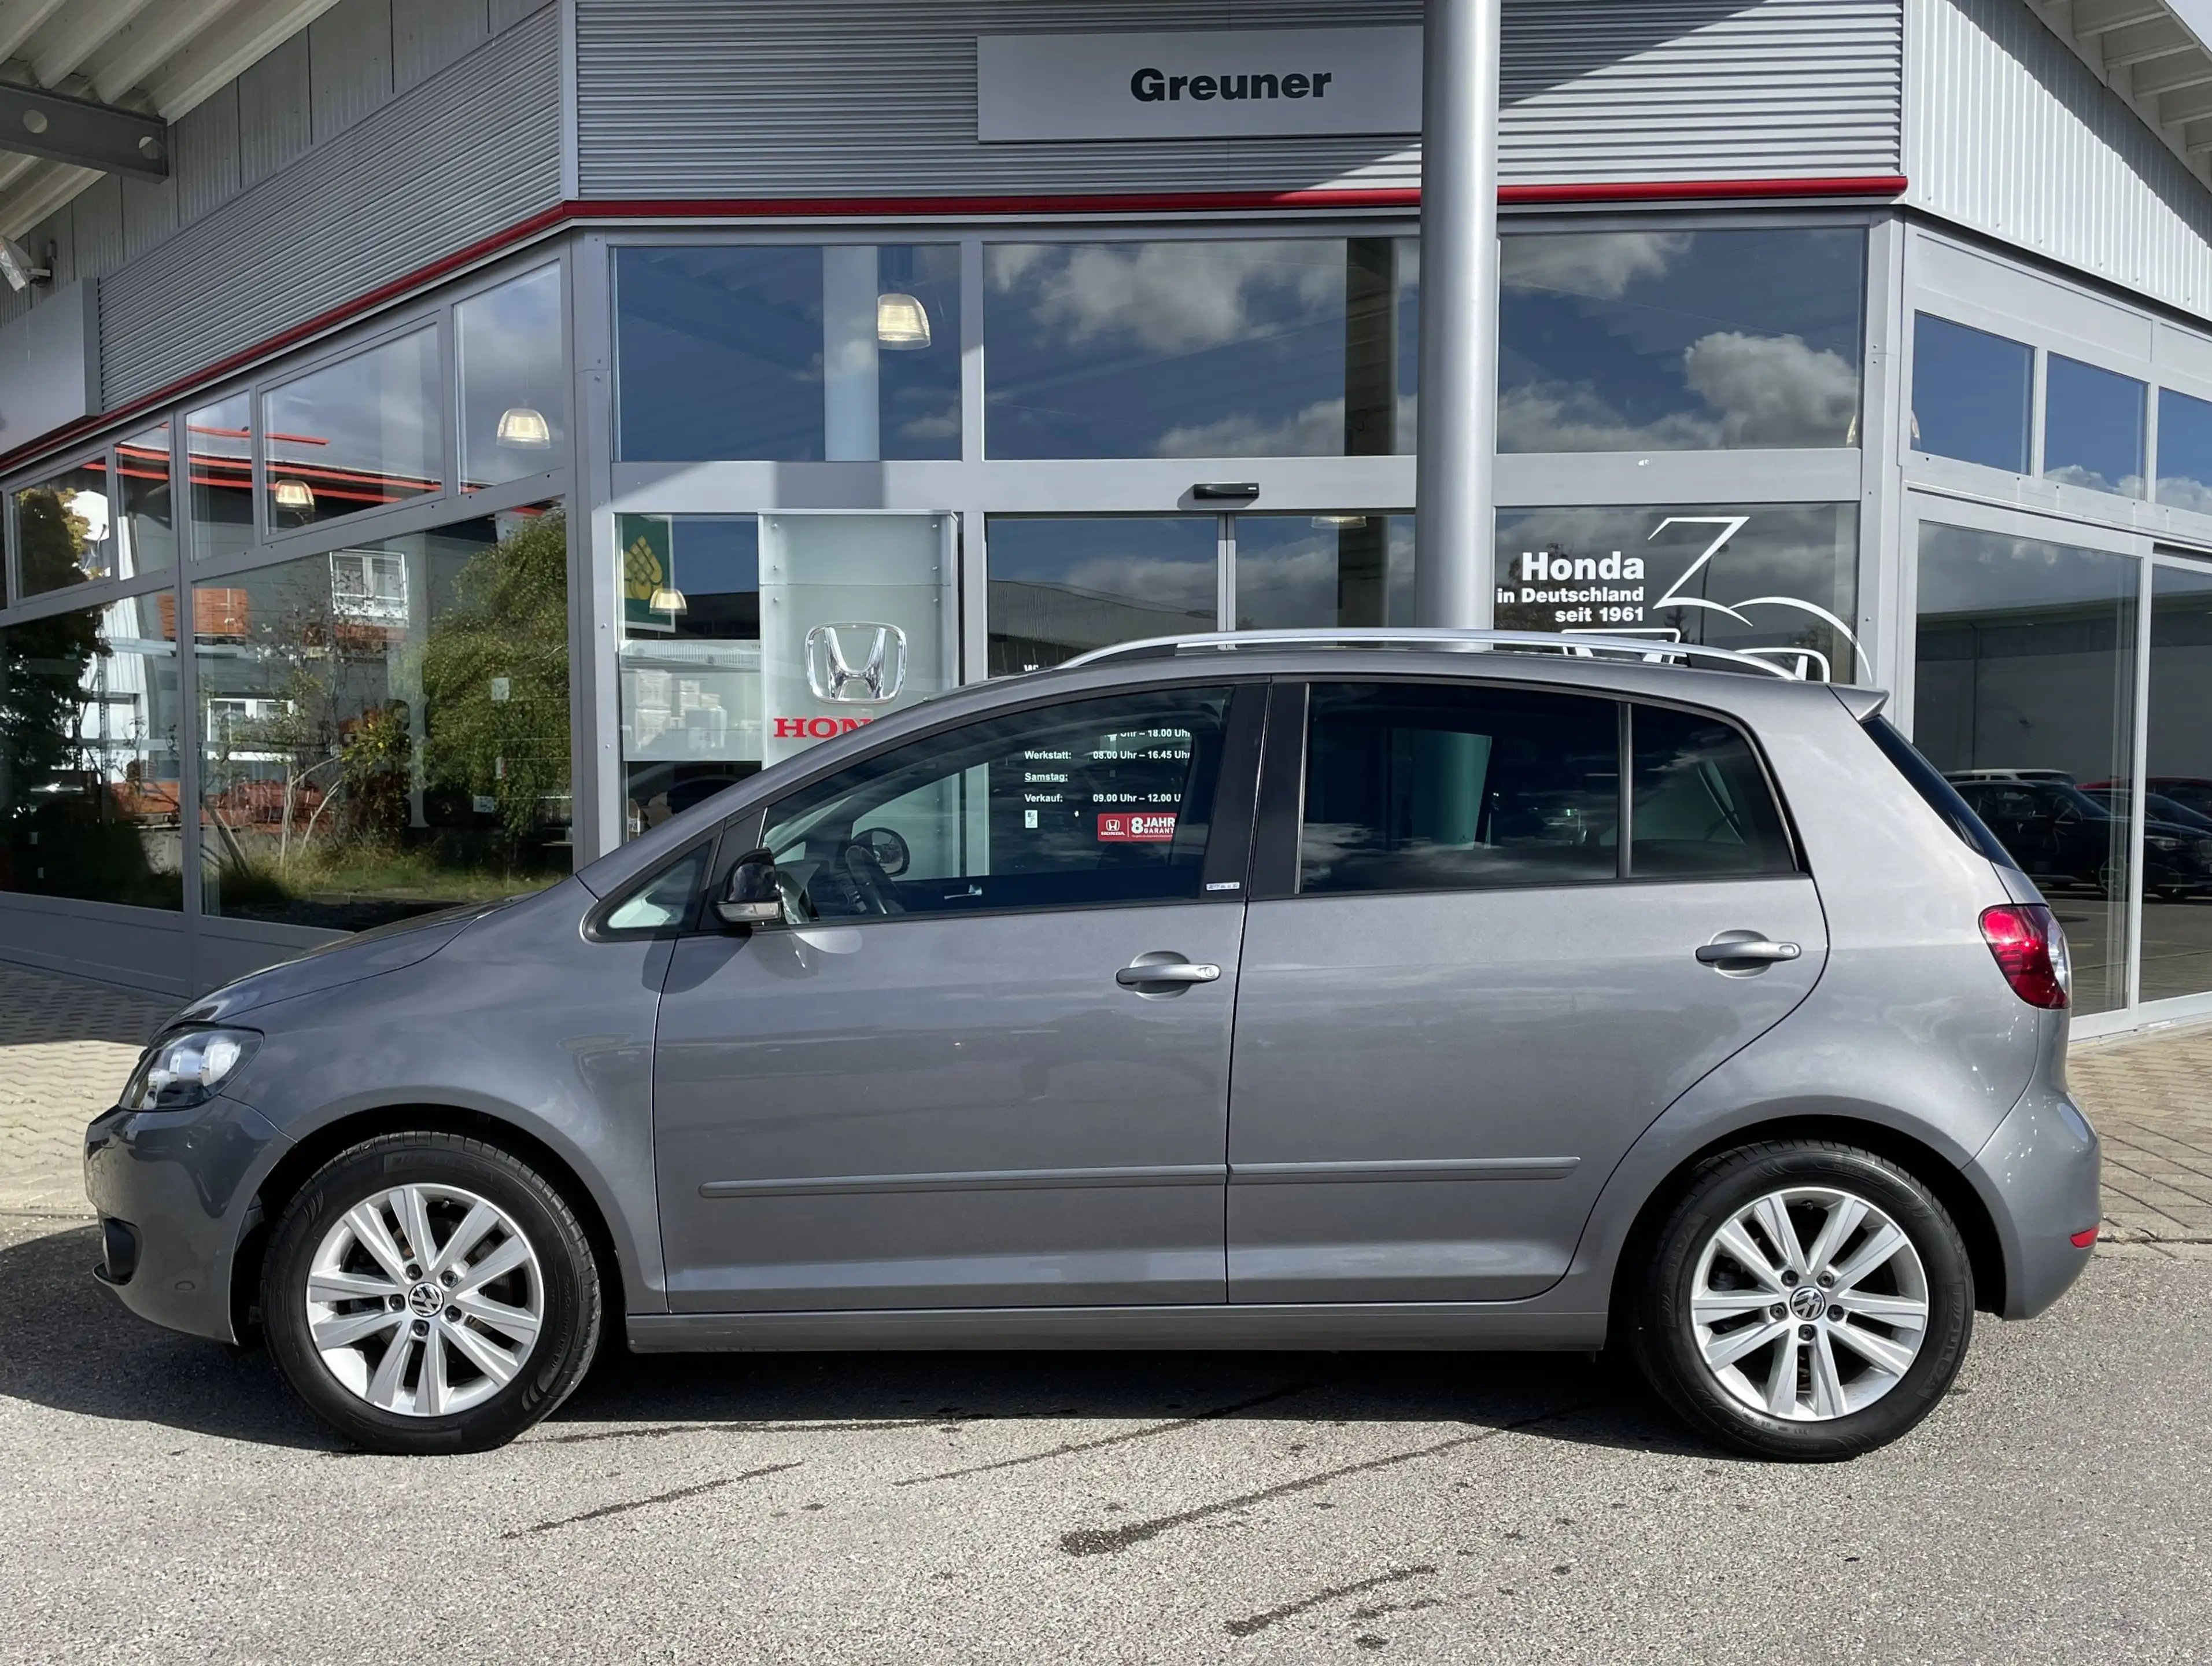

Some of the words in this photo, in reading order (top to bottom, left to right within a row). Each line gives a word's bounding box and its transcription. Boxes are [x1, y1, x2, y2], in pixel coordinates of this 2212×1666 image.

[1131, 68, 1332, 102] Greuner
[1522, 551, 1645, 581] Honda
[1497, 588, 1515, 603] in
[1522, 586, 1644, 603] Deutschland
[1555, 607, 1592, 622] seit
[1599, 606, 1644, 622] 1961
[1147, 728, 1172, 738] 18.00
[1024, 750, 1072, 760] Werkstatt:
[1093, 751, 1117, 760] 08.00
[1120, 750, 1138, 759] Uhr
[1147, 750, 1172, 759] 16.45
[1024, 772, 1068, 783] Samstag:
[1024, 794, 1063, 802] Verkauf:
[1093, 794, 1117, 802] 09.00
[1120, 794, 1138, 802] Uhr
[1147, 794, 1172, 802] 12.00
[1131, 817, 1143, 834] 8
